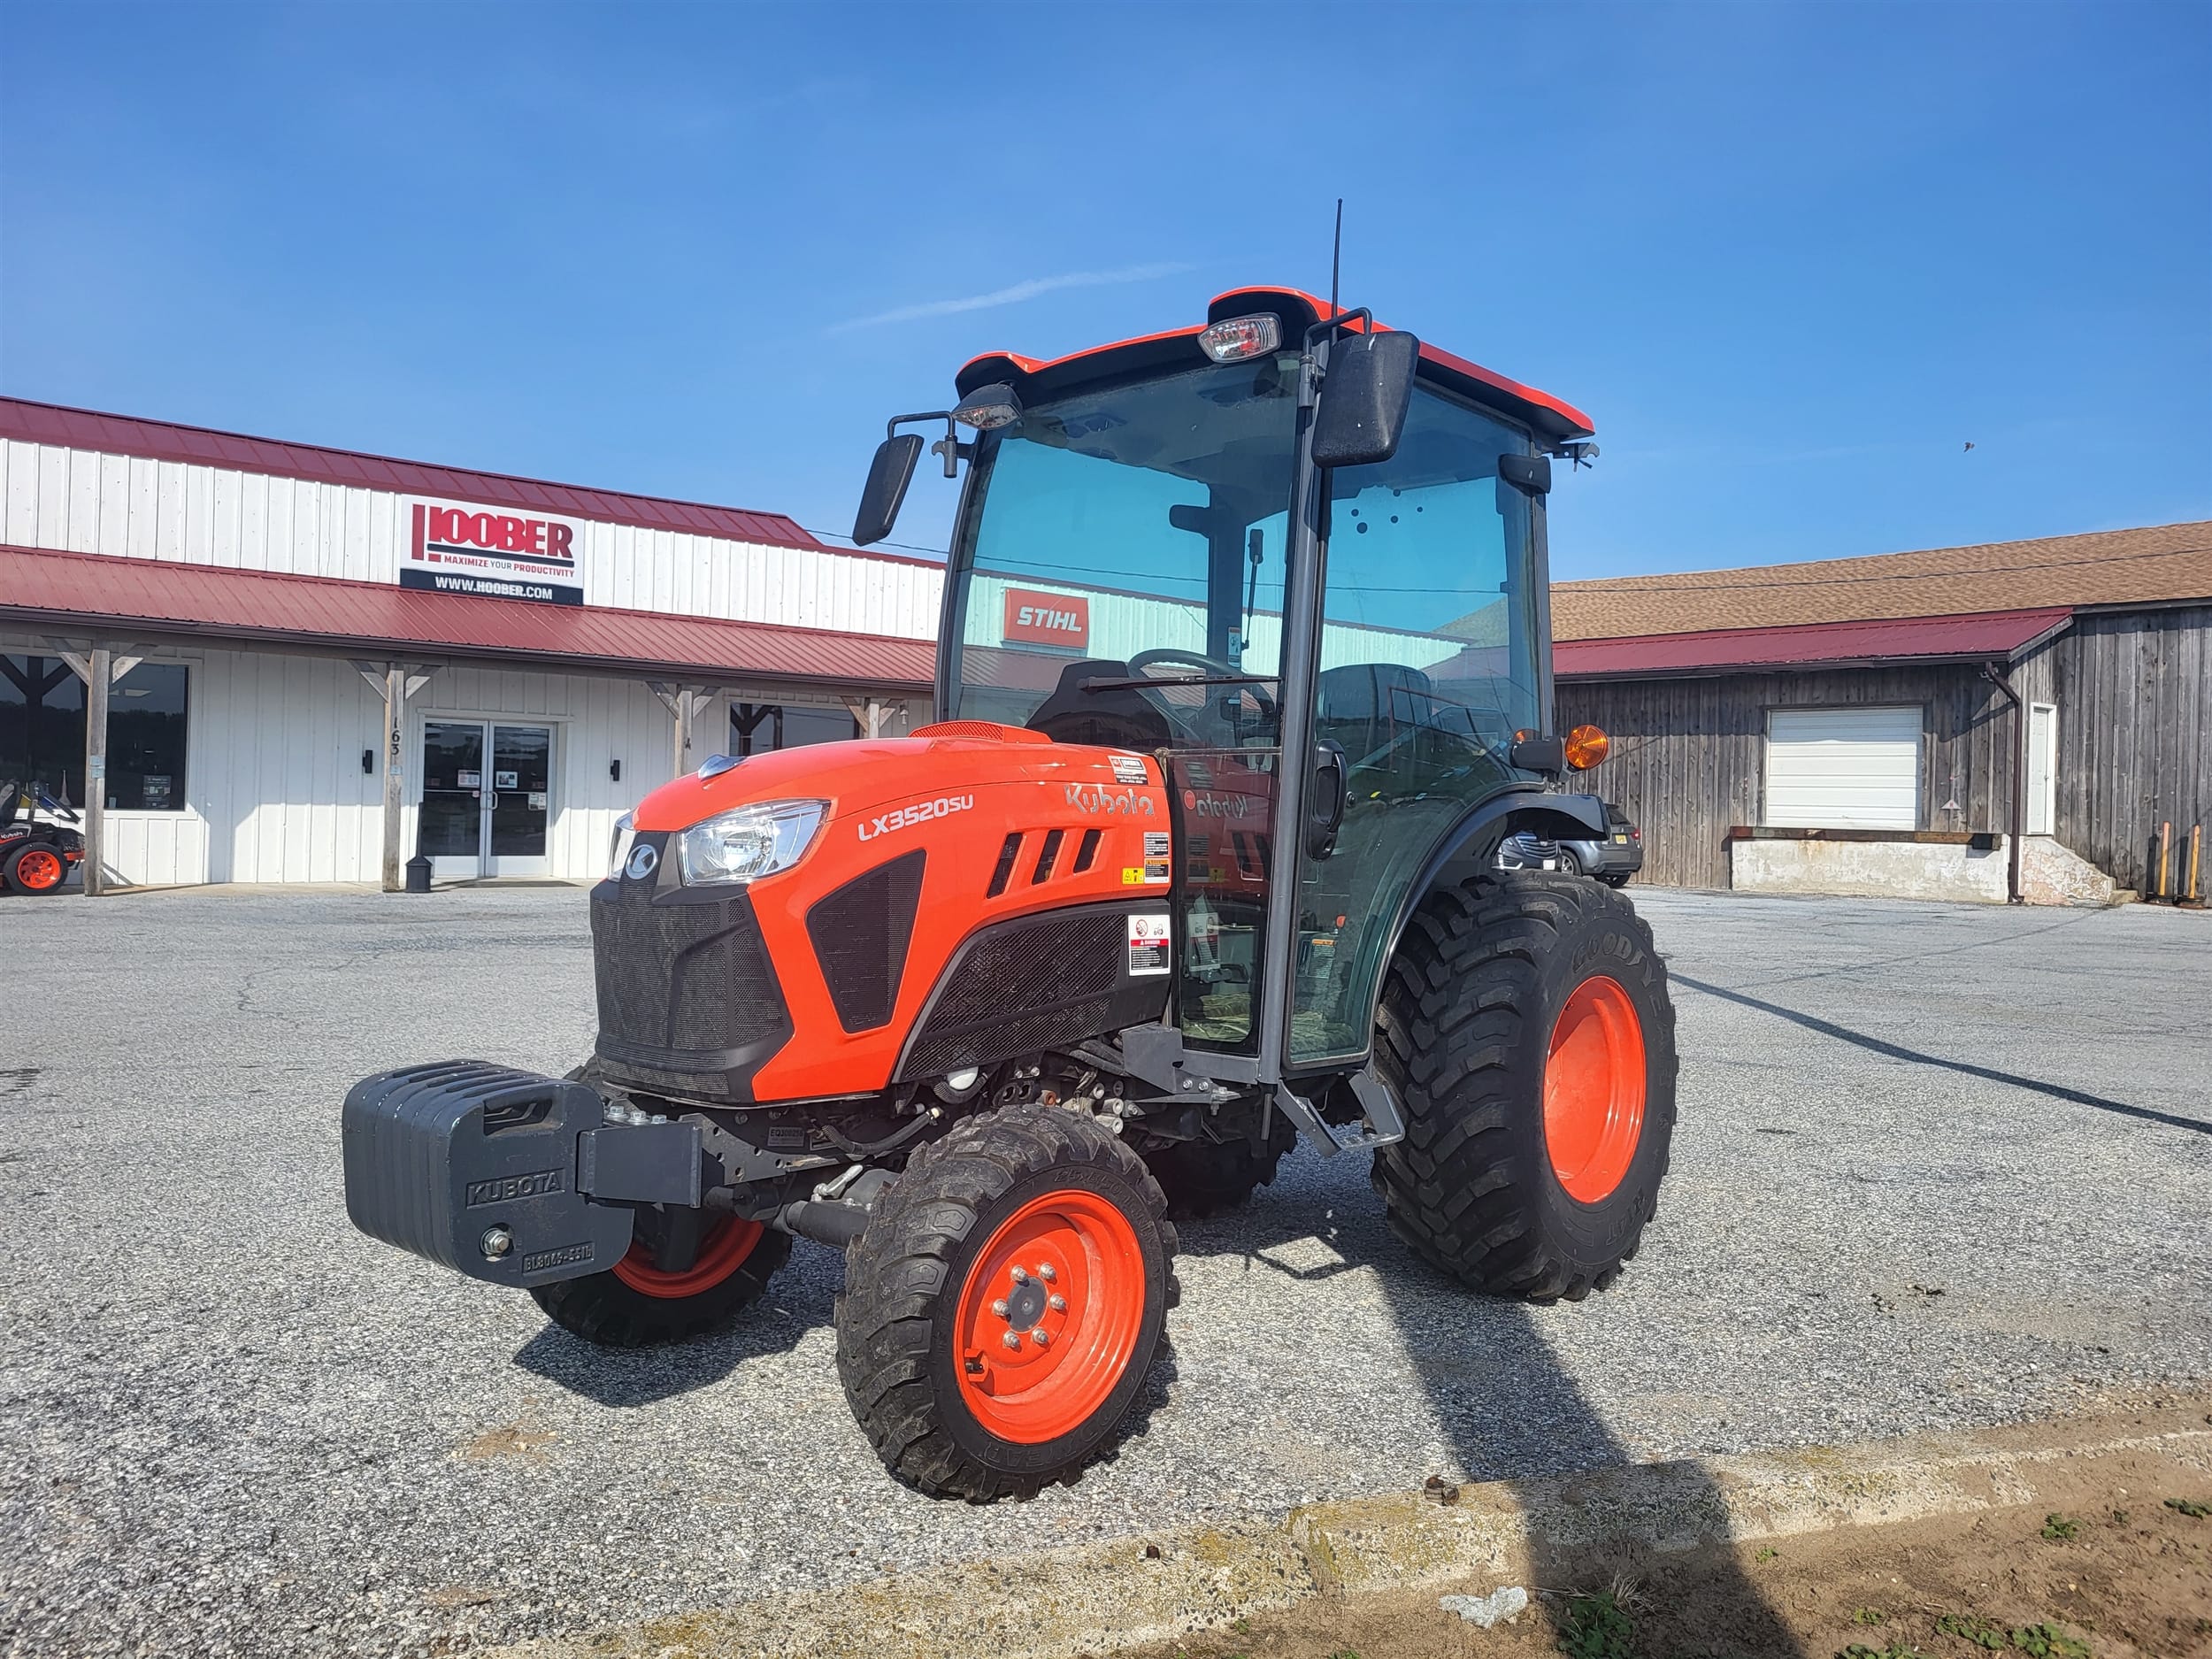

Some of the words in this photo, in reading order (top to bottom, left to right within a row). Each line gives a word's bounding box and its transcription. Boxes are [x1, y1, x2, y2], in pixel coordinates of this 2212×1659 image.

[411, 503, 573, 561] HOOBER
[444, 556, 488, 568] MAXIMIZE
[490, 560, 512, 570] YOUR
[513, 563, 574, 578] PRODUCTIVITY
[434, 575, 553, 600] WWW.HOOBER.COM
[1017, 606, 1082, 632] STIHL
[390, 716, 400, 756] 163
[1064, 785, 1155, 815] Kubota
[857, 794, 974, 841] LX3520SU
[468, 1172, 561, 1206] KUBOTA
